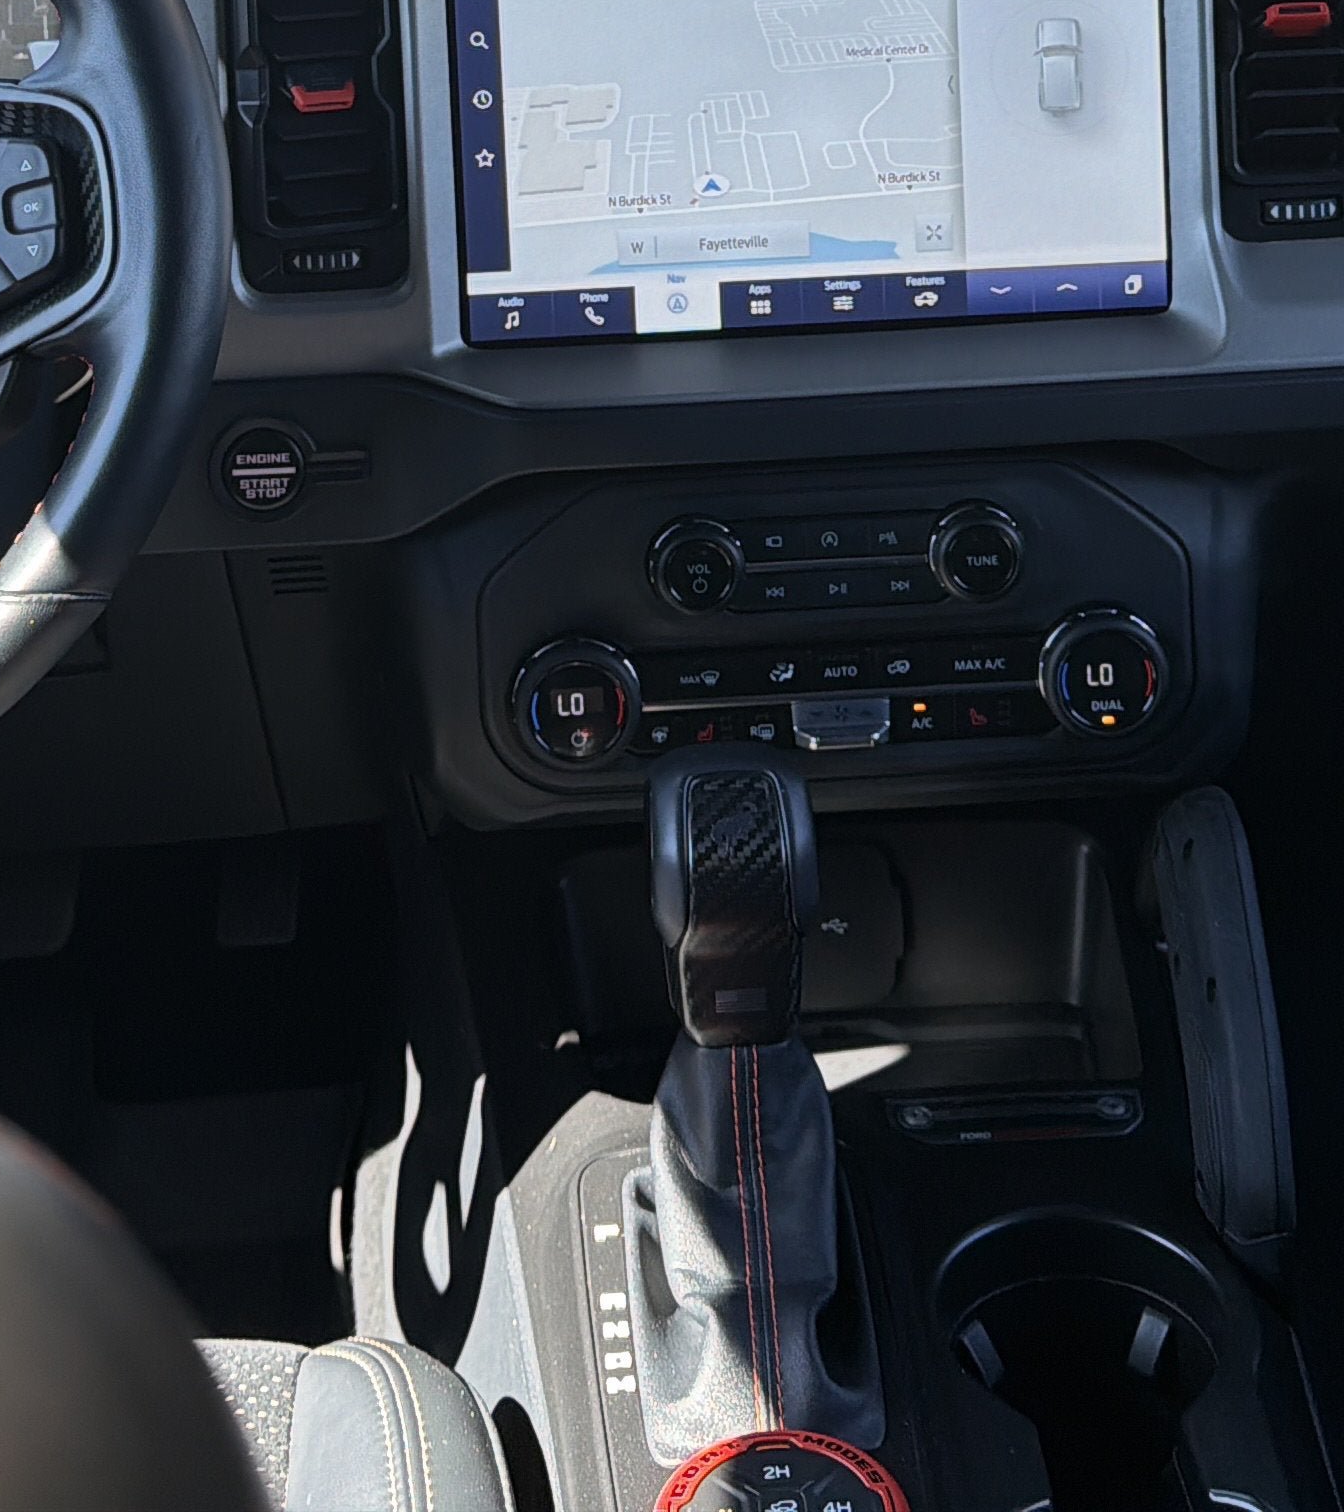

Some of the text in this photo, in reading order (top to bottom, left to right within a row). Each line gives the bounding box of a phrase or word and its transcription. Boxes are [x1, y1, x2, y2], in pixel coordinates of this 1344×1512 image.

[845, 45, 884, 57] Medical
[885, 44, 914, 56] Center
[877, 169, 941, 185] N Burdick St
[607, 193, 671, 207] N Burdick St
[23, 201, 39, 214] OK
[630, 240, 644, 254] W
[698, 232, 769, 253] Fayetteville
[666, 273, 686, 284] Nav
[905, 274, 945, 287] Features
[748, 282, 771, 296] Apps
[824, 278, 862, 293] Settings
[498, 296, 524, 308] Audio
[579, 291, 608, 303] Phone
[236, 453, 291, 465] ENGINE
[239, 477, 290, 489] START
[245, 488, 286, 499] STOP
[965, 554, 1000, 567] TUNE
[687, 563, 712, 575] VOL
[954, 657, 1006, 672] MAX A/C
[823, 665, 858, 678] AUTO
[680, 674, 701, 686] MAX
[1090, 697, 1125, 712] DUAL
[912, 716, 934, 730] A/C
[959, 1131, 992, 1141] FORD
[802, 1434, 885, 1485] MODES
[762, 1465, 791, 1480] 2H
